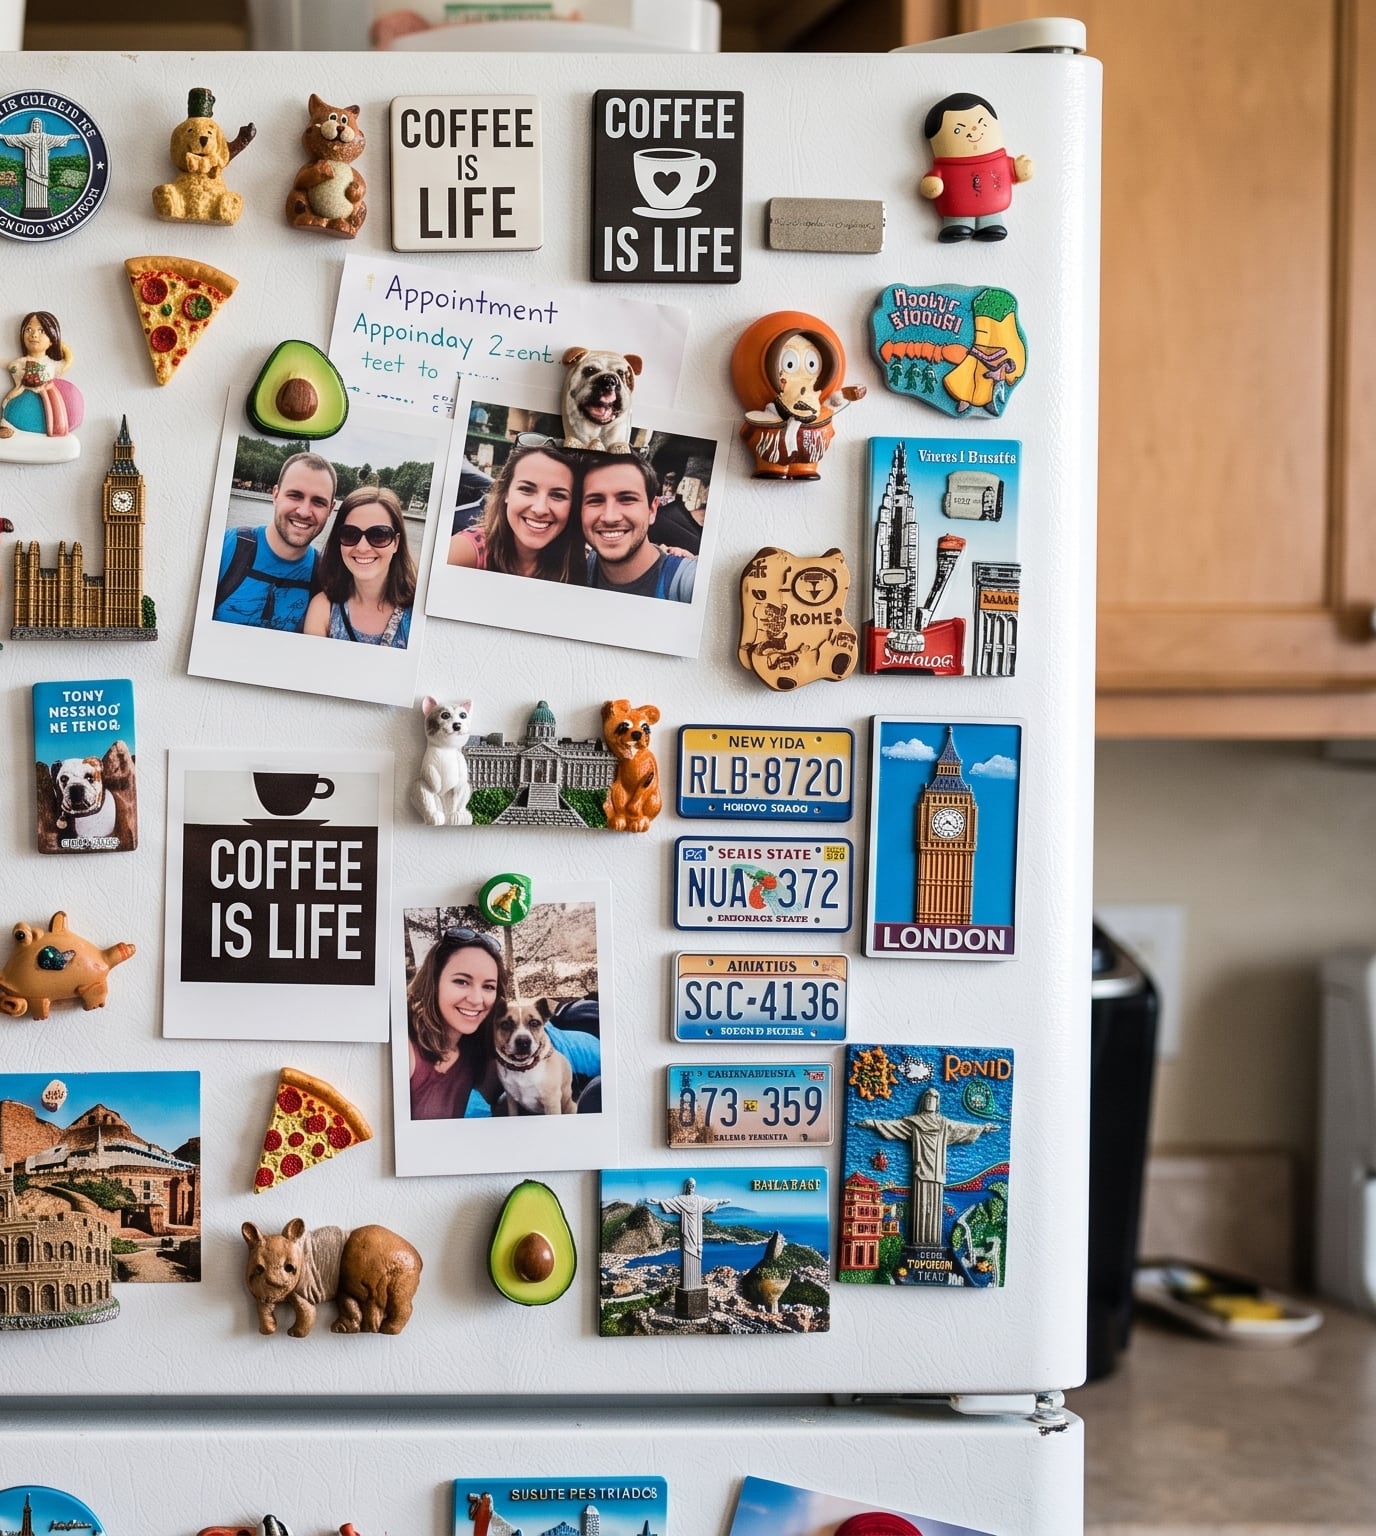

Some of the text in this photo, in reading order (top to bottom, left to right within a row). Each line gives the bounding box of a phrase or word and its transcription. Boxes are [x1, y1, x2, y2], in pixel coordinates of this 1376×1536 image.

[400, 108, 534, 149] COFFEE
[604, 97, 736, 139] COFFEE
[456, 154, 478, 181] IS
[419, 186, 517, 239] LIFE
[604, 226, 735, 274] IS LIFE
[385, 274, 559, 324] Appointment
[352, 312, 474, 361] Appoinday
[62, 690, 104, 703] TONY
[729, 736, 805, 750] NEW YIDA
[690, 755, 844, 797] RLB-8720
[210, 838, 363, 891] COFFEE
[766, 849, 812, 861] STATE
[688, 866, 840, 909] NUA 372
[211, 902, 362, 960] IS LIFE
[775, 915, 809, 923] STATE
[883, 926, 1006, 951] LONDON
[684, 980, 840, 1021] SCC-4136
[762, 1086, 823, 1127] 359
[511, 1488, 566, 1501] SUSUTE
[570, 1488, 596, 1500] PES
